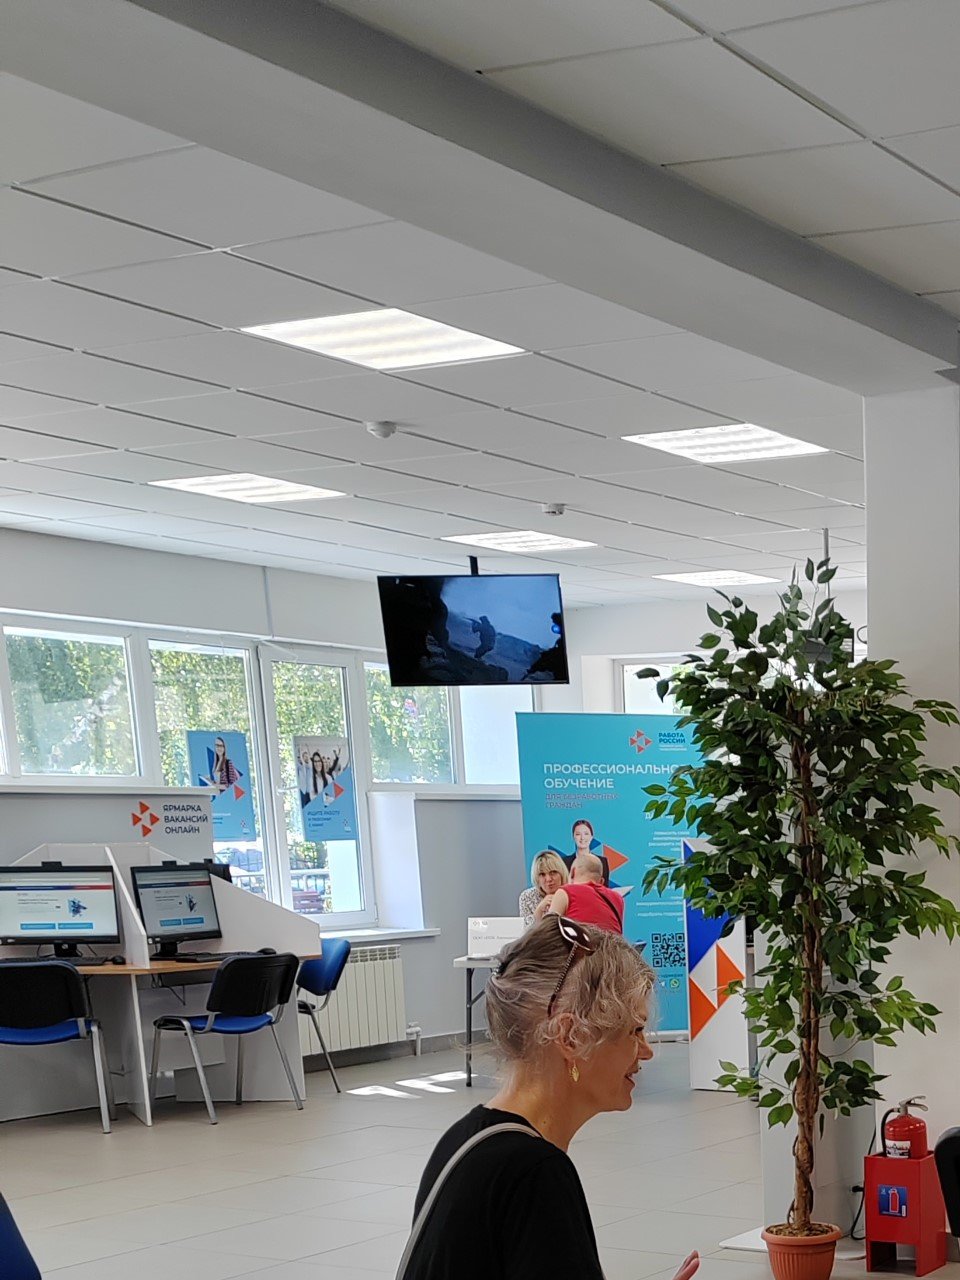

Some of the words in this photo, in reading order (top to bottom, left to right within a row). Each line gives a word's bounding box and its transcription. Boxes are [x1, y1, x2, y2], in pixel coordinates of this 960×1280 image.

[544, 778, 615, 789] ОБУЧЕНИЕ
[162, 804, 202, 812] ЯРМАРКА
[163, 813, 208, 823] ВАКАНСИЙ
[164, 825, 200, 834] ОНЛАЙН
